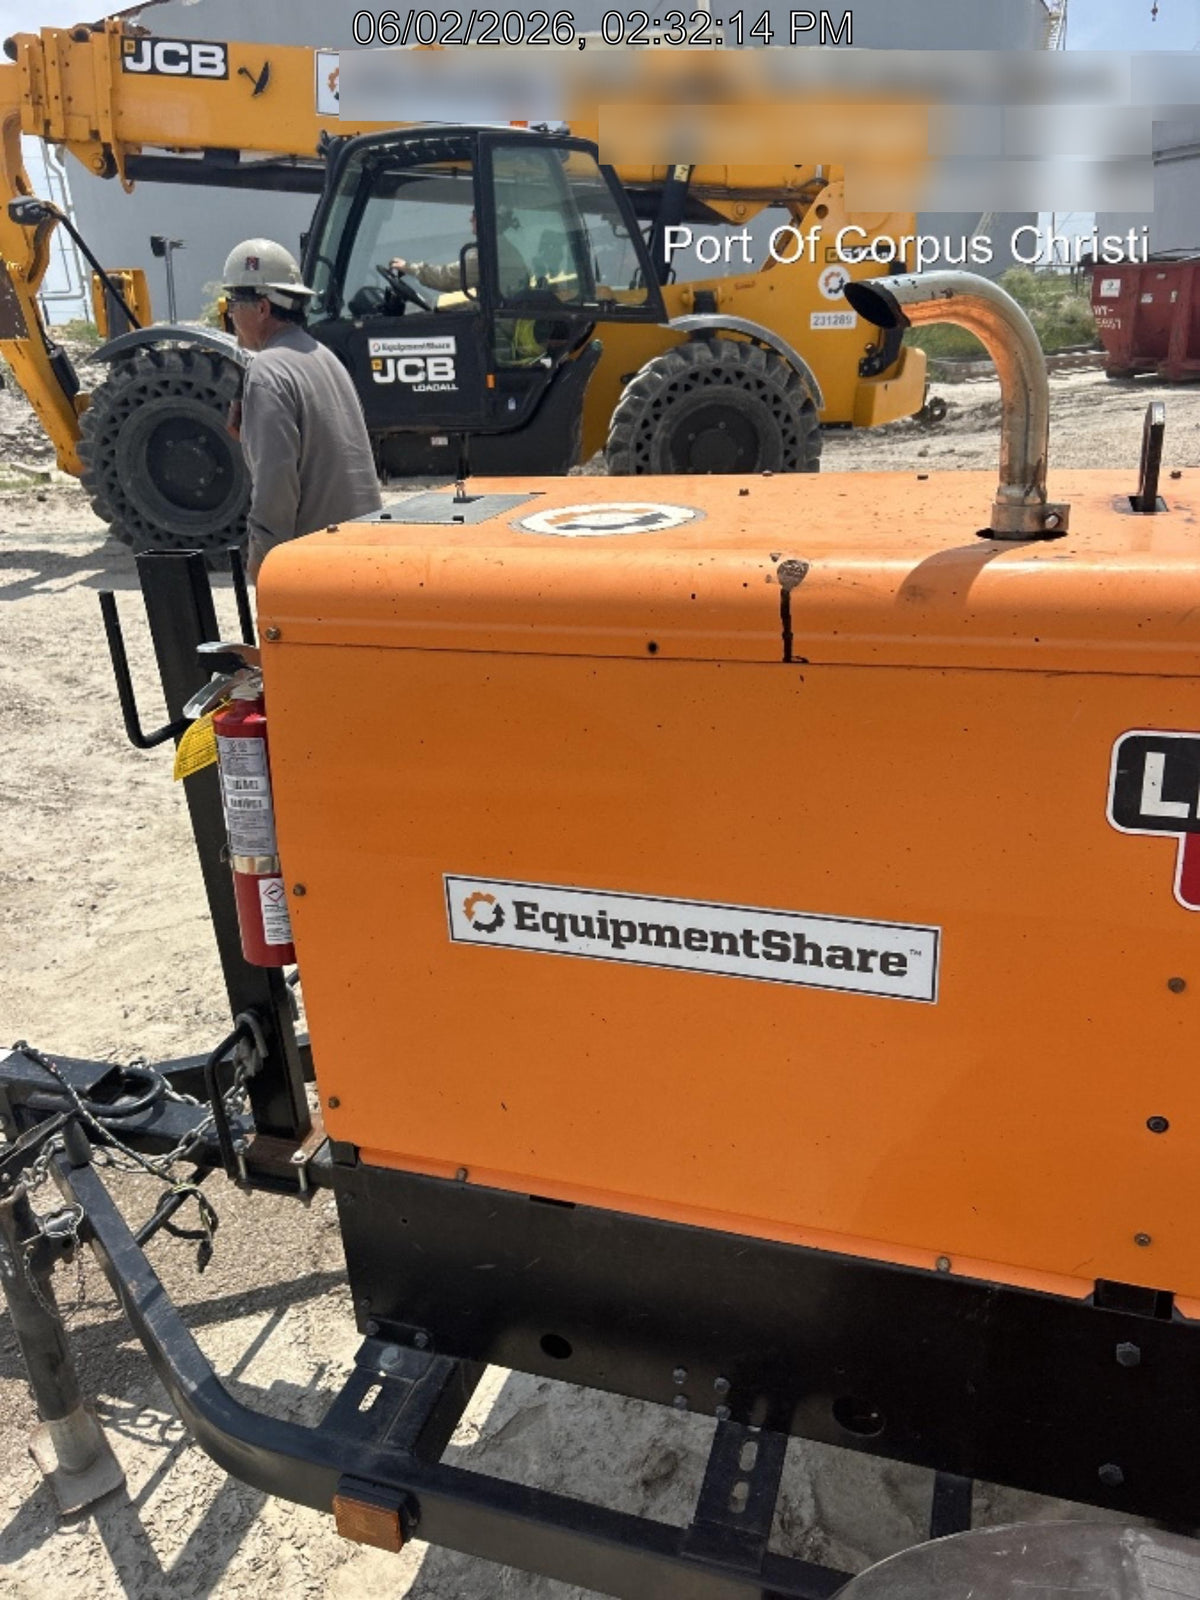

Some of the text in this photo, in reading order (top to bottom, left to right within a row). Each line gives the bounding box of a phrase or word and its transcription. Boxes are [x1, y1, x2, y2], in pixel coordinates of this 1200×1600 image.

[124, 40, 226, 77] JCB
[372, 357, 456, 383] JCB
[412, 383, 459, 392] LOADALL
[1139, 751, 1200, 820] L
[512, 900, 908, 978] EquipmentShare
